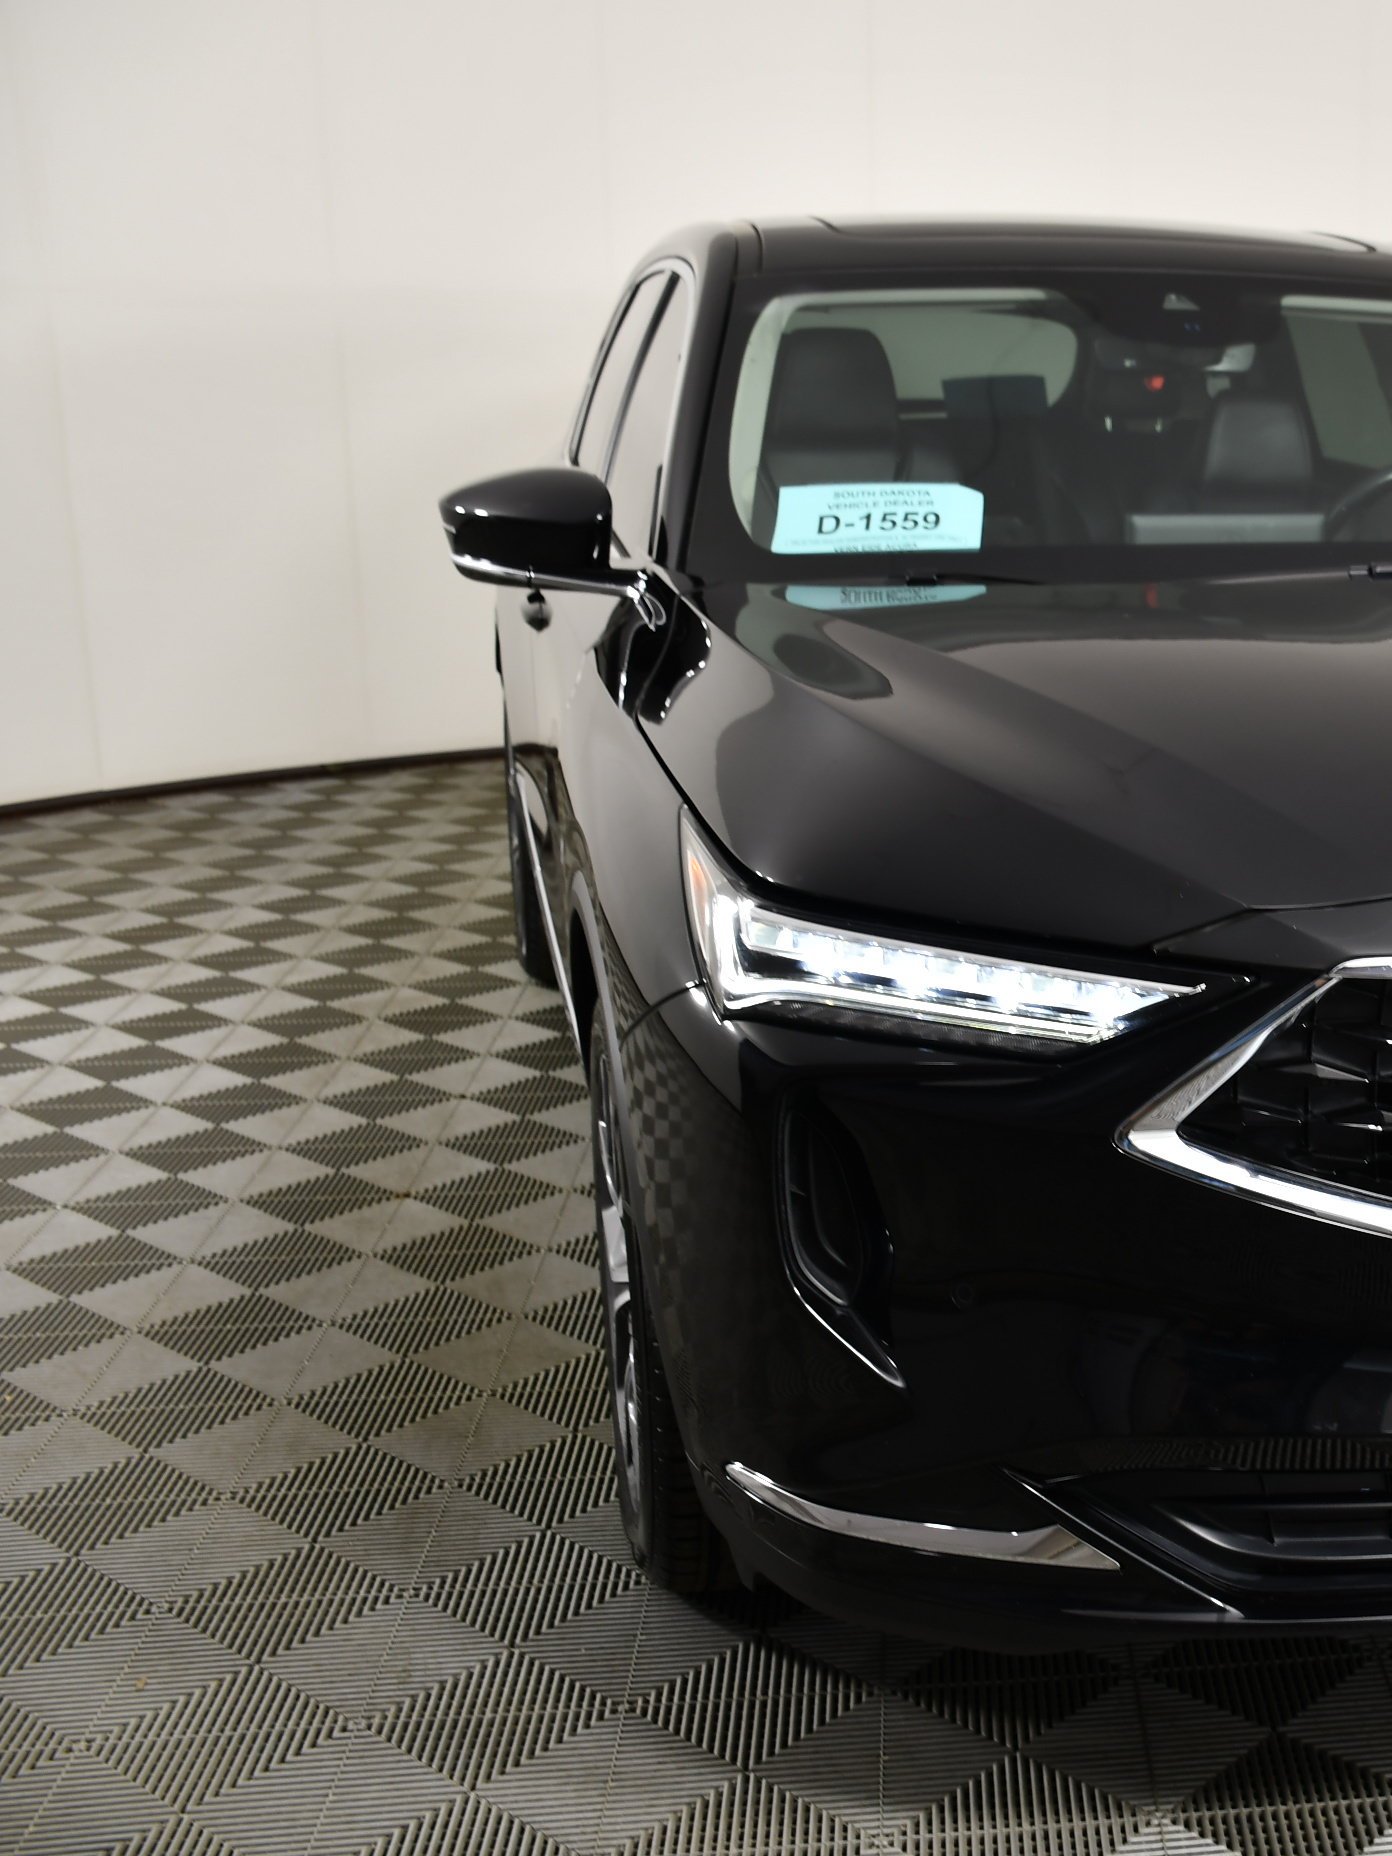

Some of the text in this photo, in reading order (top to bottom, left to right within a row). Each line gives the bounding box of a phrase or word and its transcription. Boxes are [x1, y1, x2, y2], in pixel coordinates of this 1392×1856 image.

[833, 489, 931, 500] SOUTH DAKOTA
[827, 499, 935, 510] VEHICLE DEALER
[817, 512, 941, 535] D-1559
